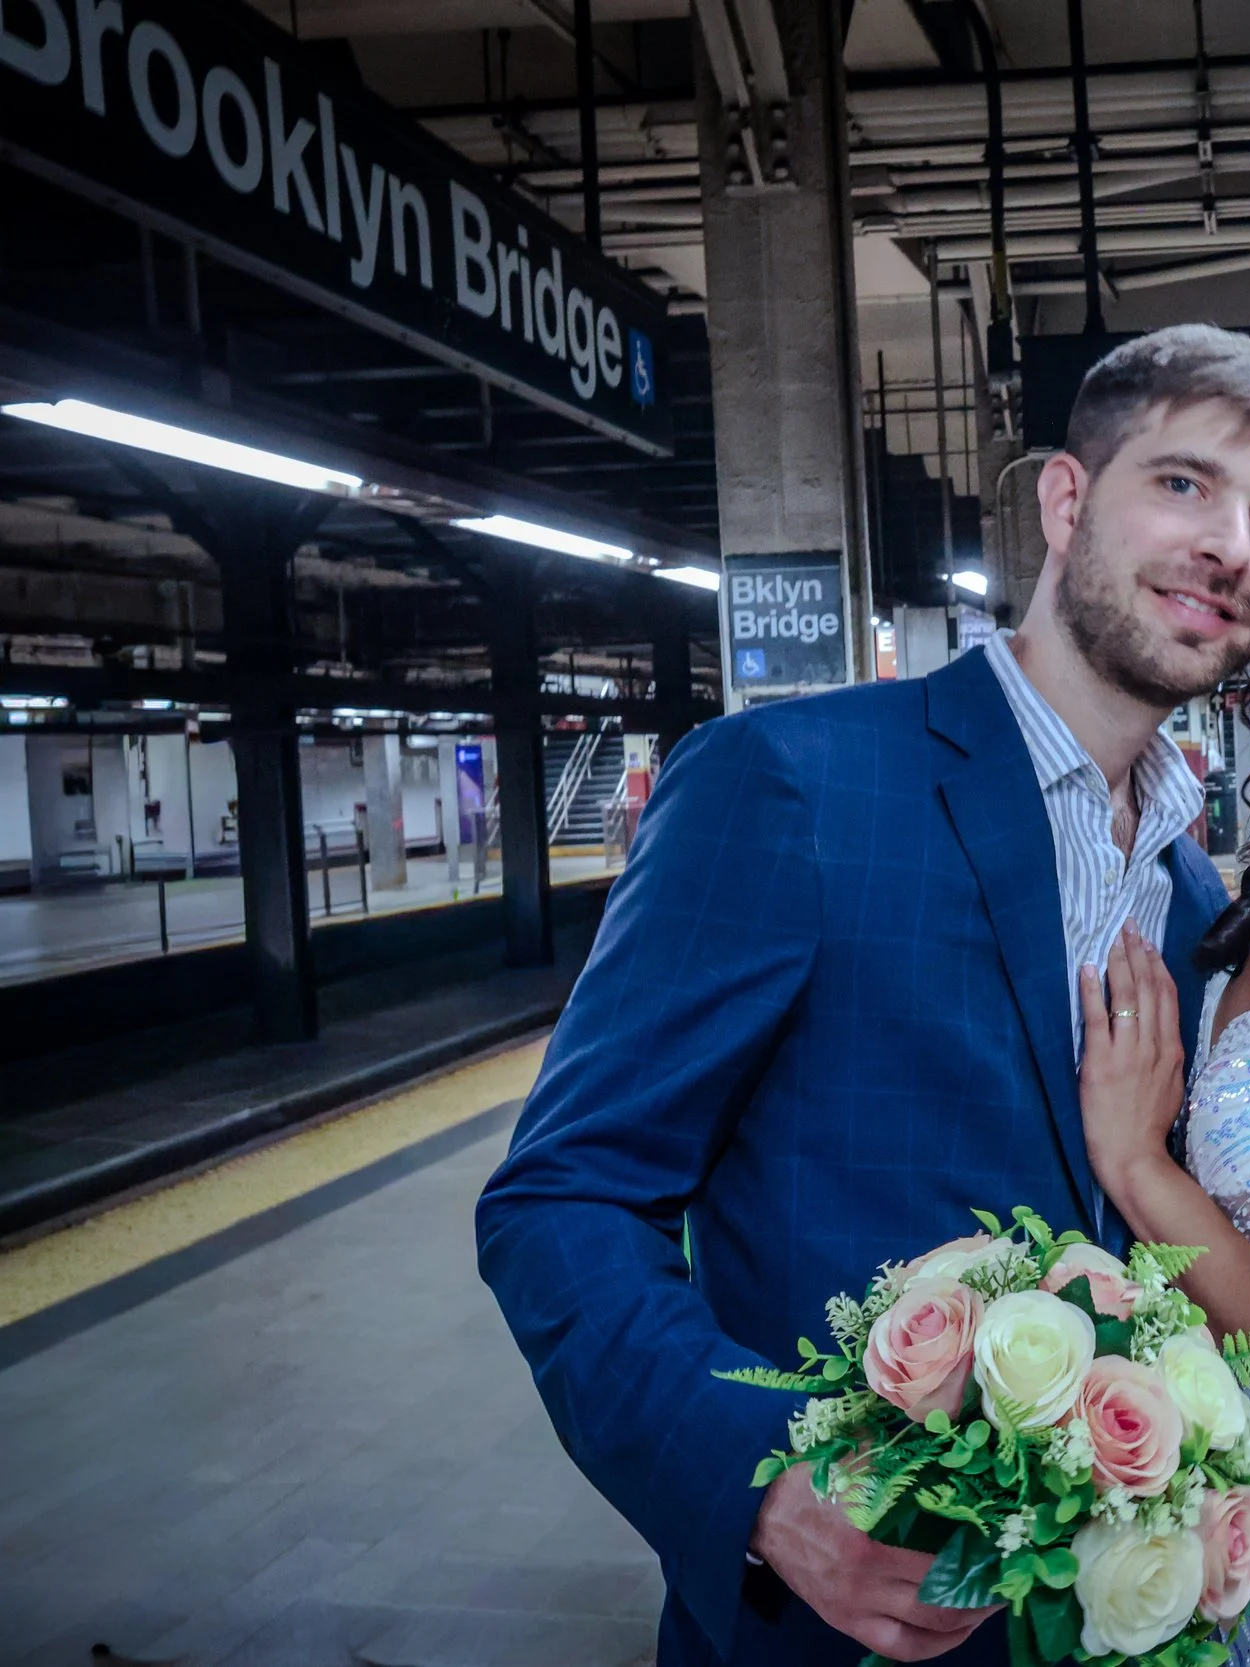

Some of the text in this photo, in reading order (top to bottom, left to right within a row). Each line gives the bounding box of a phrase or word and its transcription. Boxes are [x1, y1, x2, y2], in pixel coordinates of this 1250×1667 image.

[450, 180, 623, 399] Bridge
[732, 574, 822, 609] Bklyn
[734, 607, 839, 643] Bridge
